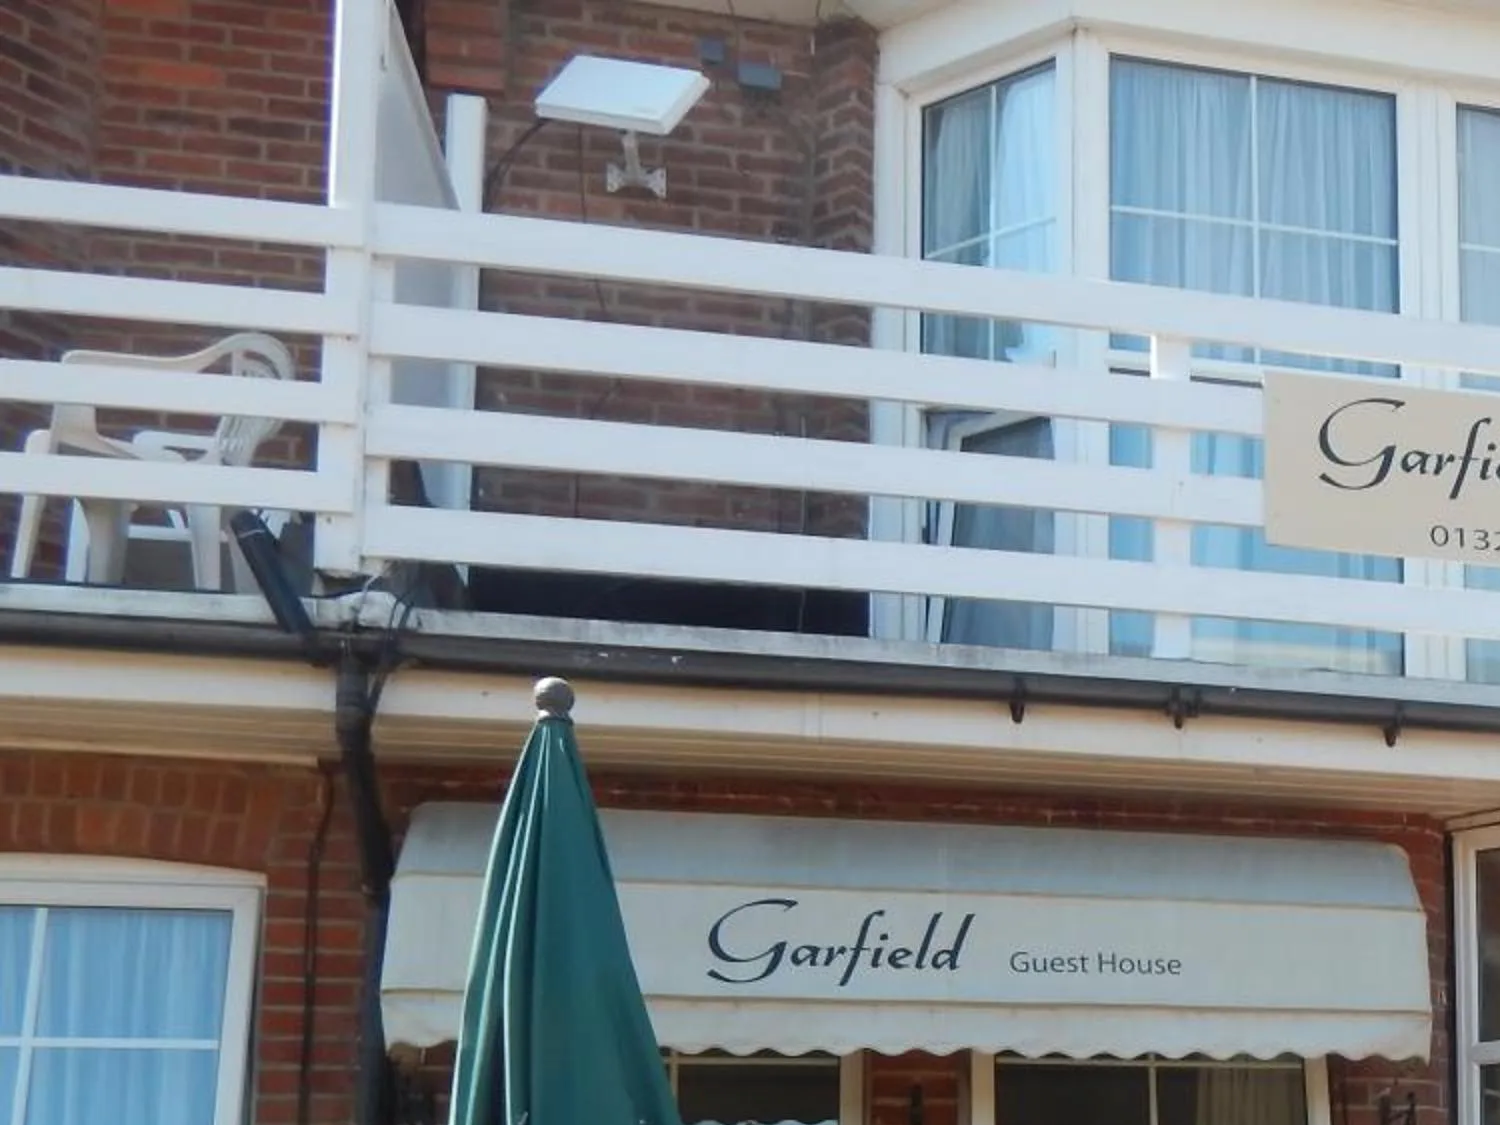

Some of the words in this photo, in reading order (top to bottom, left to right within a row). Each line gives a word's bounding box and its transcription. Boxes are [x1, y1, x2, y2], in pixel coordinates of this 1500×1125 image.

[706, 898, 976, 987] Garfield
[1009, 951, 1089, 974] Guest
[1097, 953, 1182, 976] House
